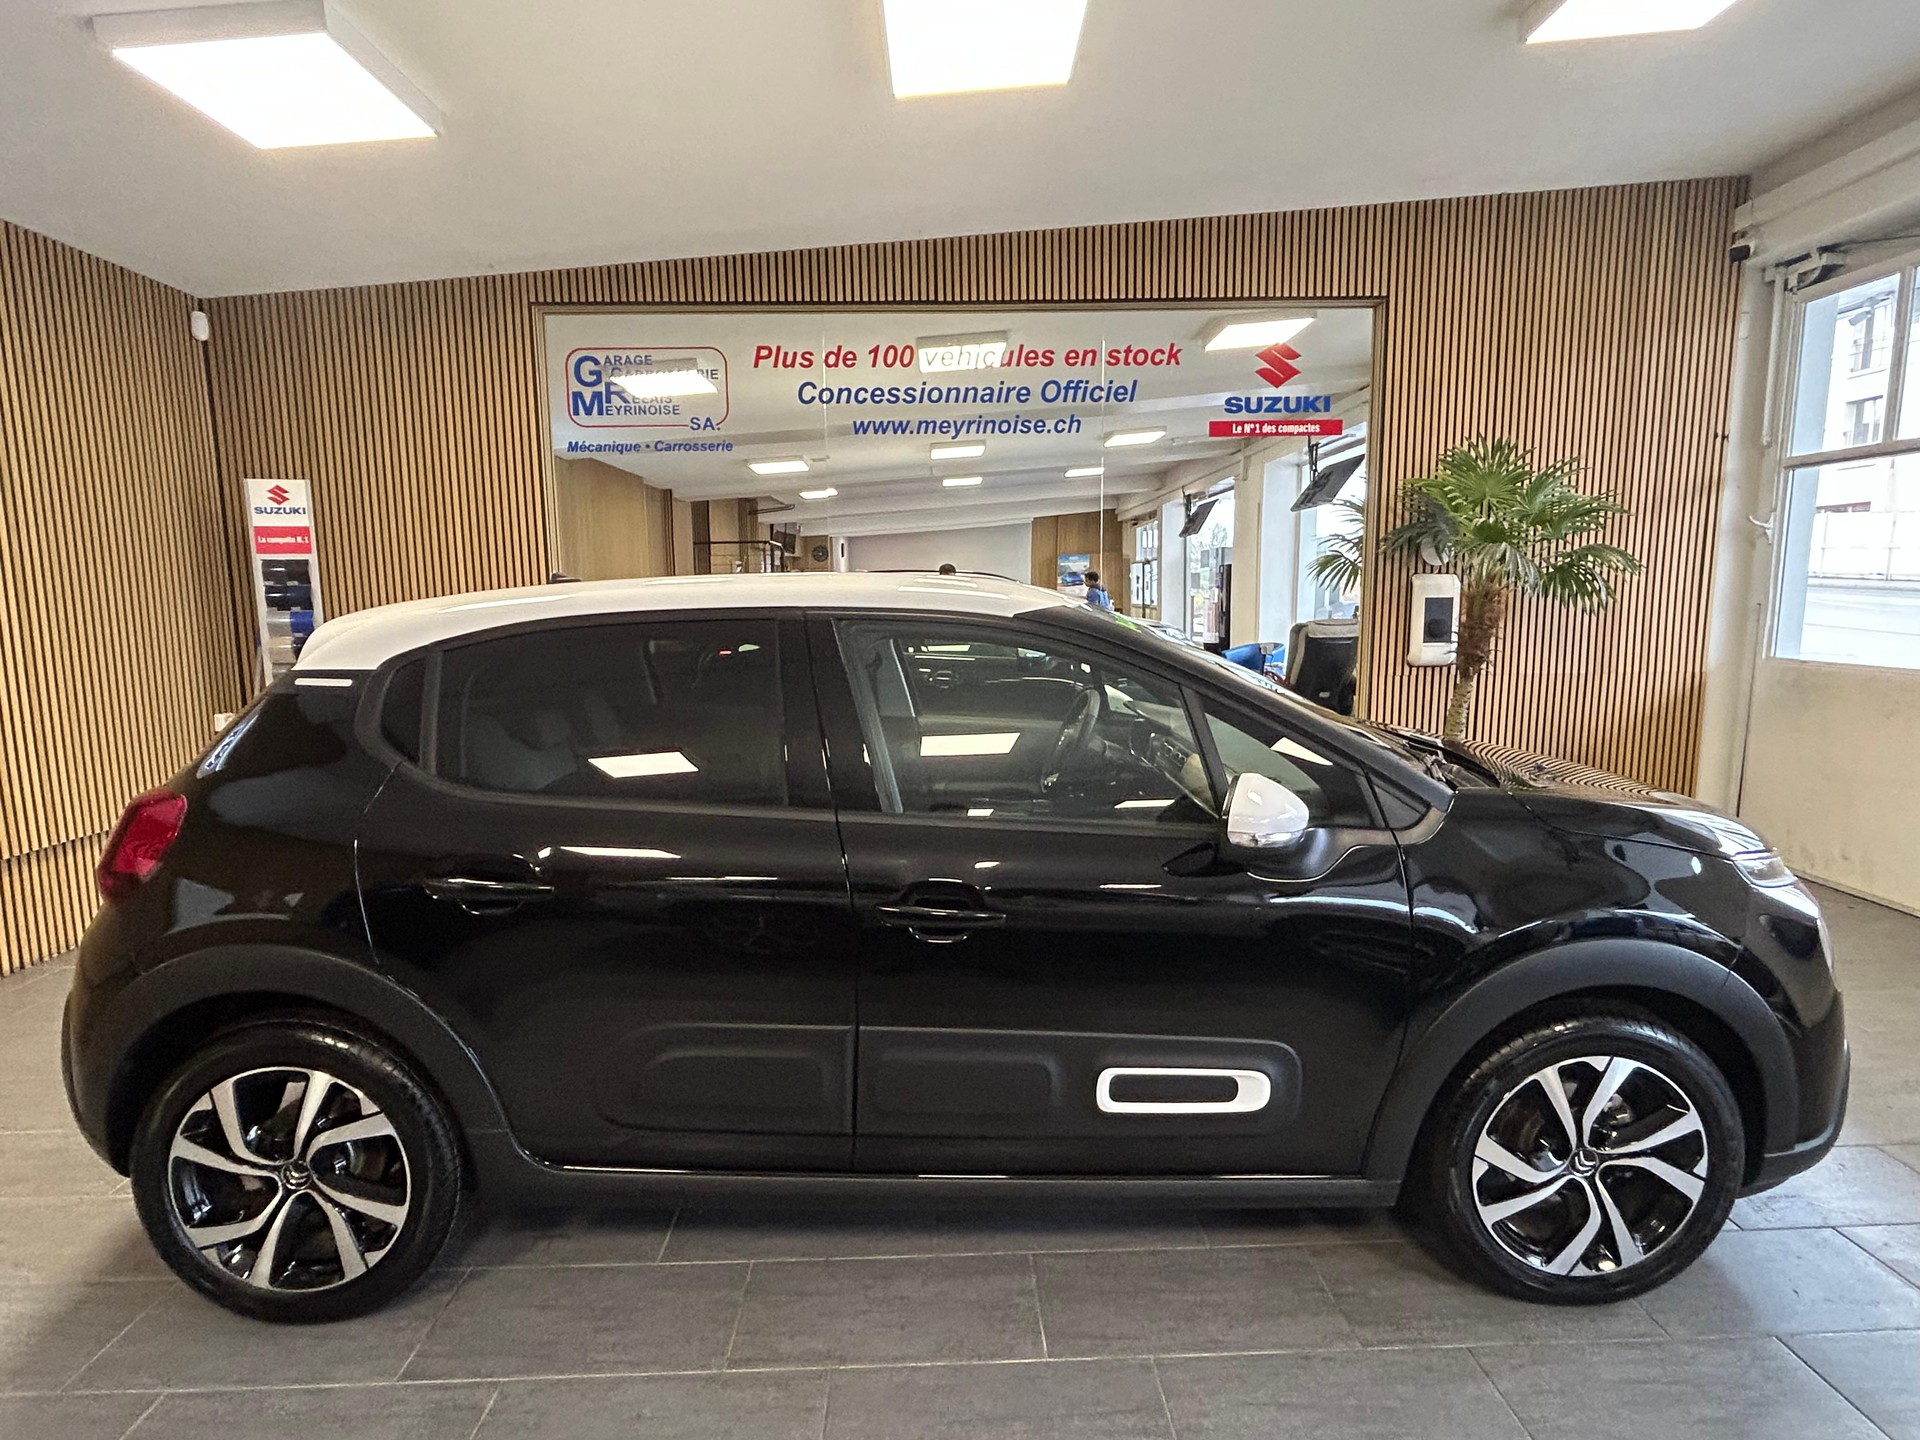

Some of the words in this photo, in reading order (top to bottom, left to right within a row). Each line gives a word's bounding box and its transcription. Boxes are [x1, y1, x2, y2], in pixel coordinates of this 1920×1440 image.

[753, 345, 814, 369] Plus
[824, 345, 858, 369] de
[867, 344, 915, 368] 100
[1064, 346, 1097, 367] en
[1106, 343, 1182, 367] stock
[797, 380, 1031, 405] Concessionnaire
[1040, 379, 1138, 403] Officiel
[1224, 395, 1331, 414] SUZUKI
[852, 414, 1082, 439] www.meyrinoise.ch
[1232, 423, 1242, 434] Le
[1262, 422, 1277, 433] des
[1278, 422, 1321, 434] compactes
[566, 441, 642, 455] Mécanique
[654, 440, 734, 452] Carrosserie
[254, 506, 307, 515] SUZUKI
